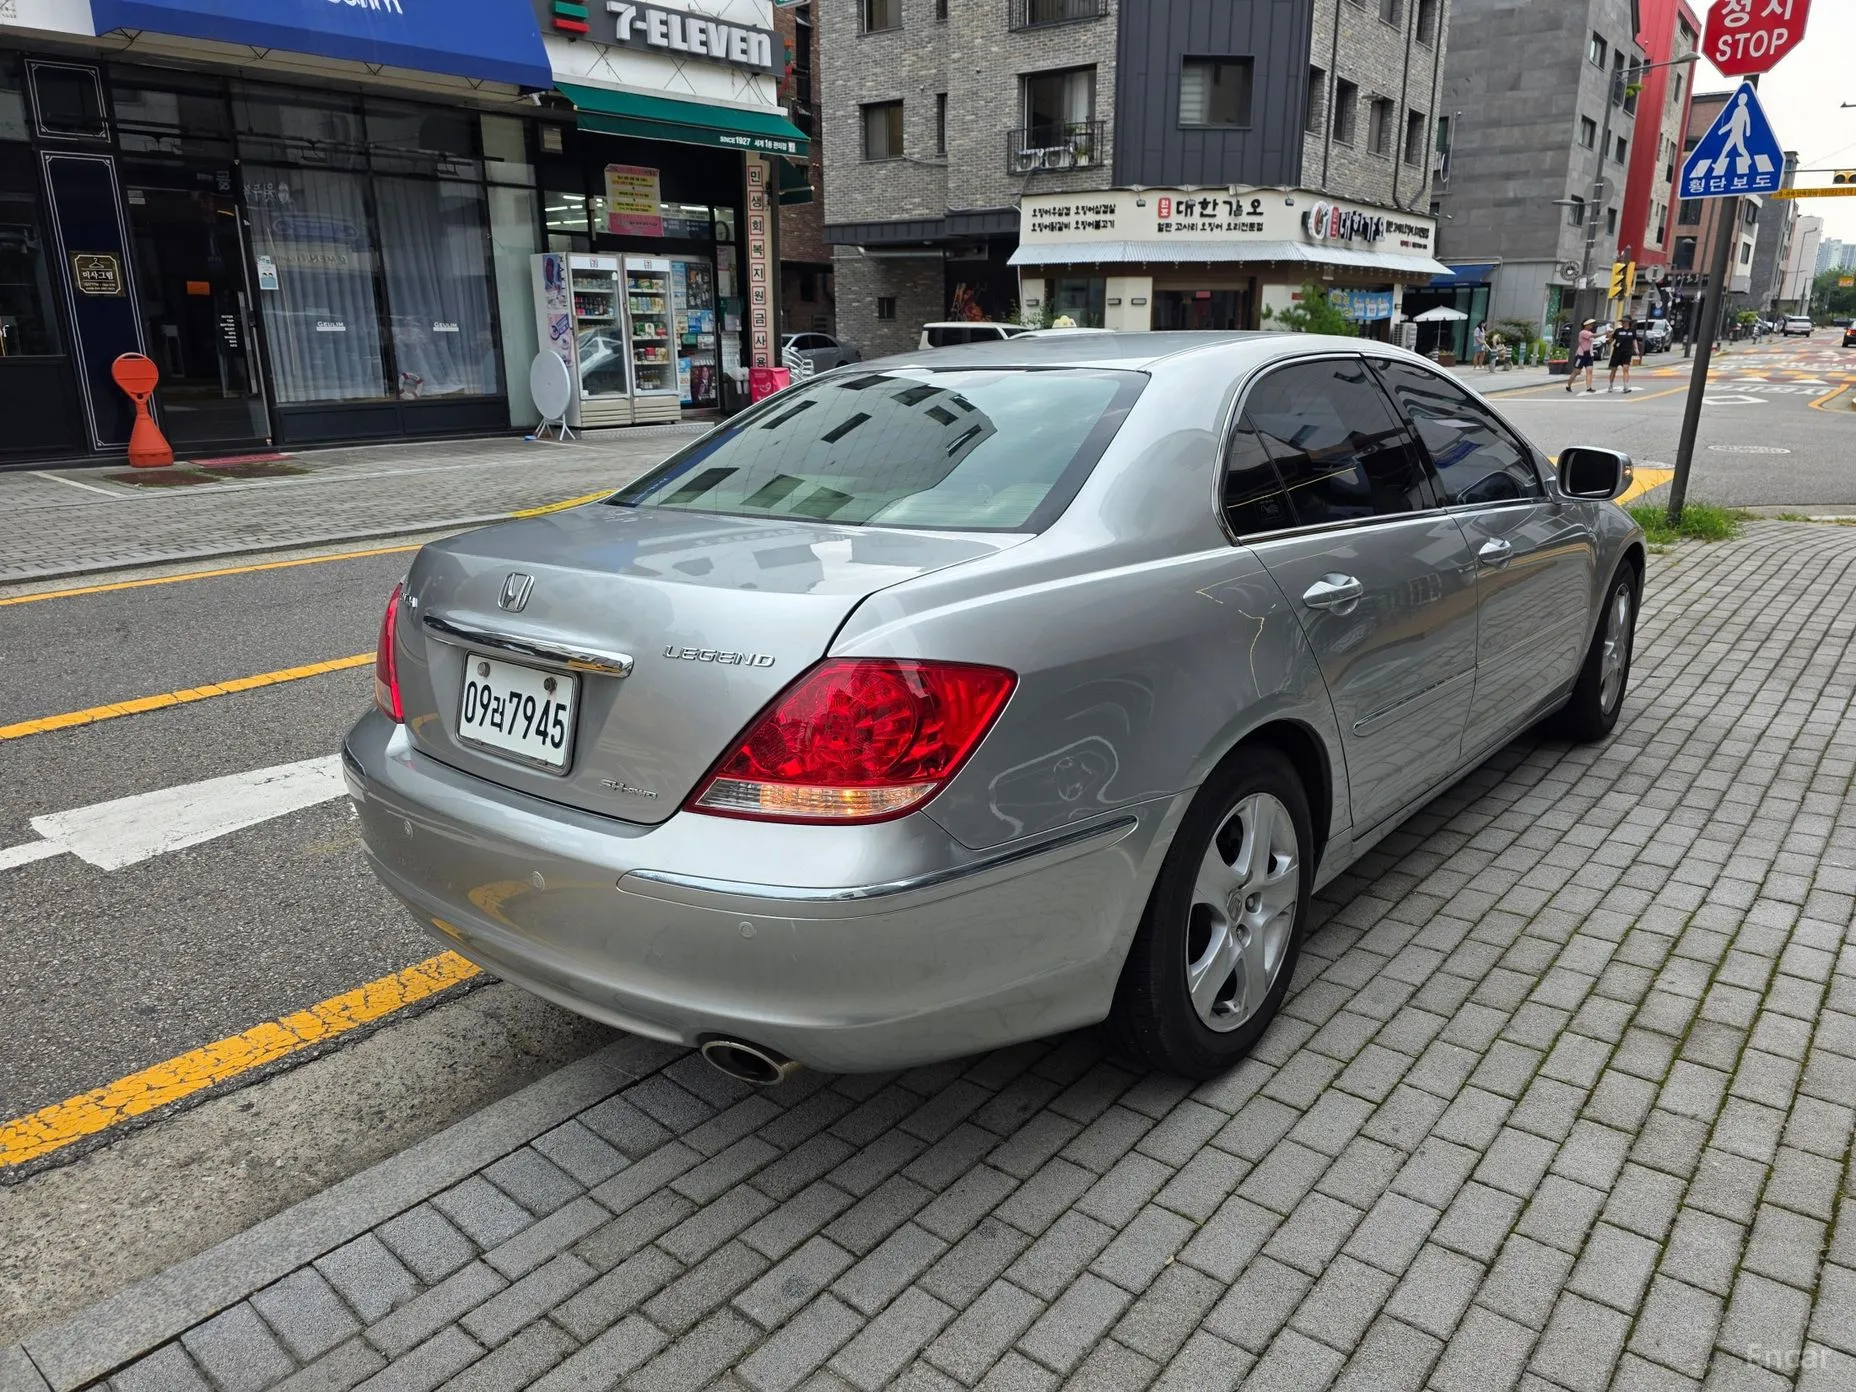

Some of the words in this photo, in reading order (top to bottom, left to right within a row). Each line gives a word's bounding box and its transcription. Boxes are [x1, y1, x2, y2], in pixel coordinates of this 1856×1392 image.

[1721, 0, 1793, 27] 정지
[1716, 28, 1788, 61] STOP
[736, 136, 751, 145] 1927
[1689, 175, 1772, 193] 횡단보도
[1175, 222, 1198, 232] 고사리
[1200, 222, 1223, 233] 오징어
[662, 644, 776, 668] LEGEND
[464, 680, 567, 749] 09러7945
